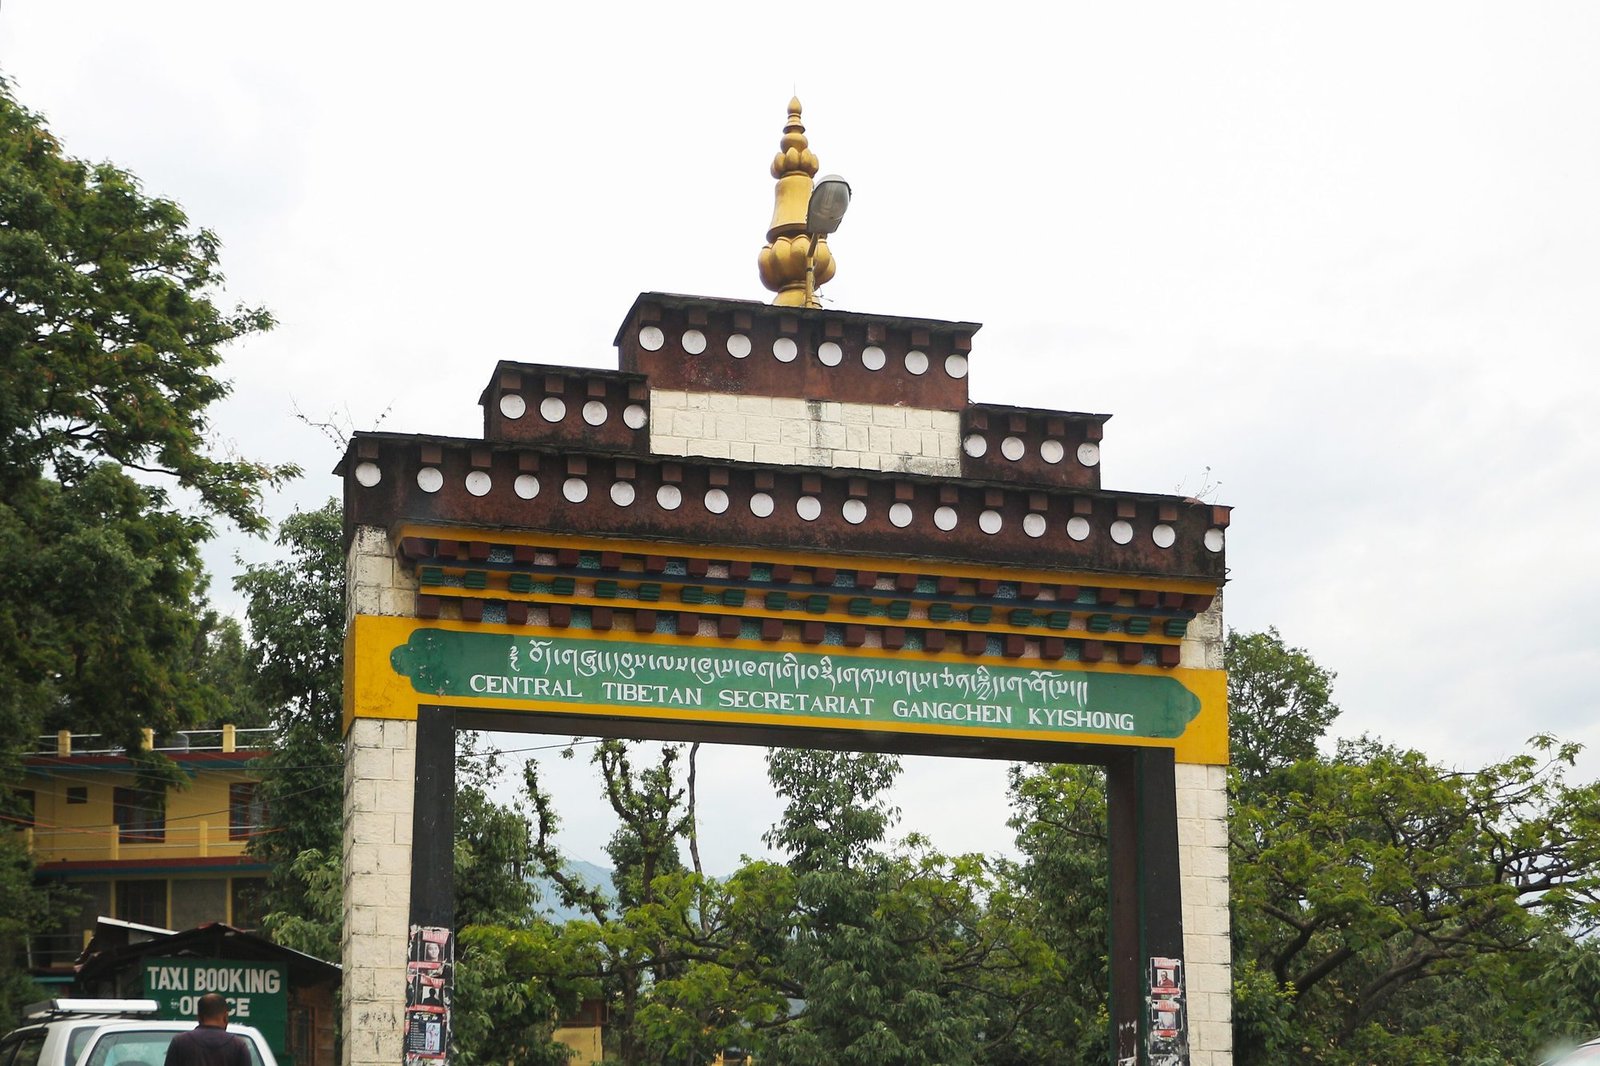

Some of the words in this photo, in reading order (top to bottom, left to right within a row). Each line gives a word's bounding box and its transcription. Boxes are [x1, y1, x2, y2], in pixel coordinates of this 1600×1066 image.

[469, 673, 583, 700] CENTRAL
[602, 682, 703, 706] TIBETAN
[718, 689, 875, 717] SECRETARIAT
[892, 699, 1013, 725] GANGCHEN
[1028, 708, 1135, 732] KYISHONG
[147, 967, 189, 991] TAXI
[194, 968, 281, 994] BOOKING
